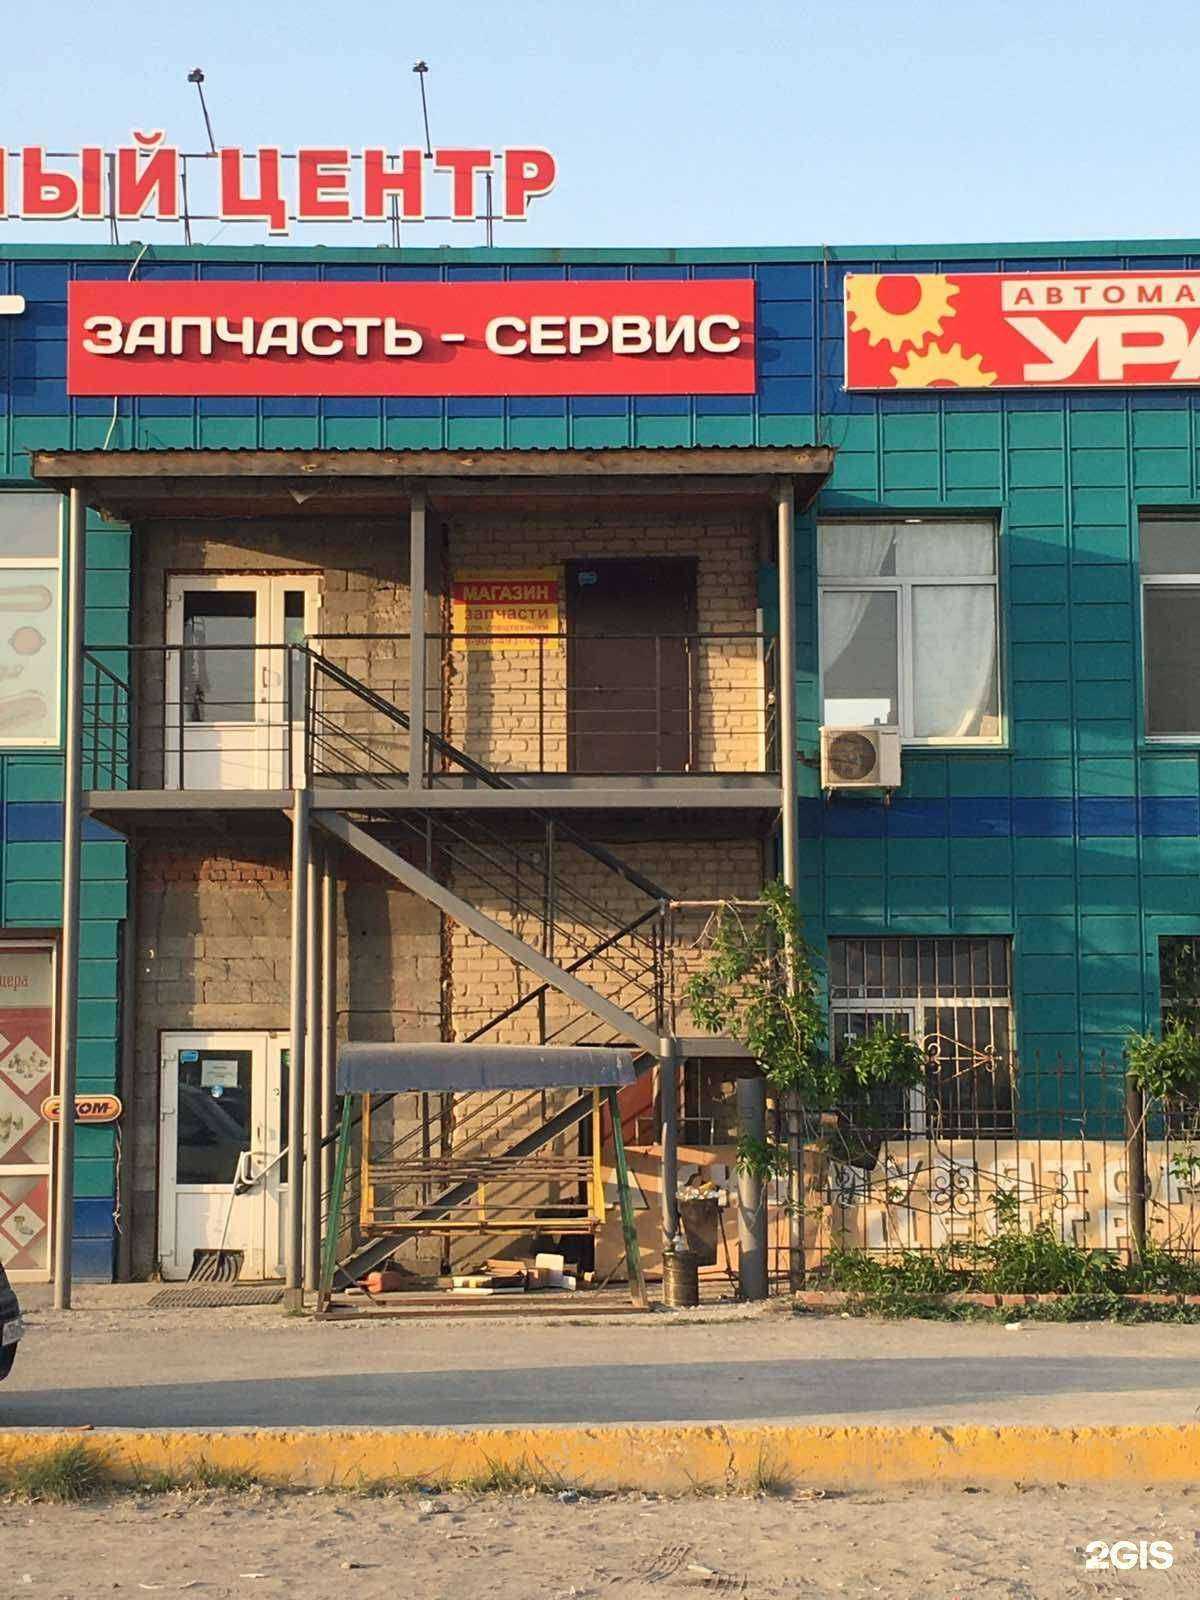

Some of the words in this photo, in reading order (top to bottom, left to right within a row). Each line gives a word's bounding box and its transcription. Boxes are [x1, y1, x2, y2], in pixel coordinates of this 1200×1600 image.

[218, 145, 558, 236] ЦЕНТР
[1014, 284, 1196, 305] АВТОМА
[82, 316, 423, 355] ЗАПЧАСТЬ
[485, 314, 741, 354] СЕРВИС
[464, 585, 549, 600] МАГАЗИН
[465, 607, 549, 620] запчасти
